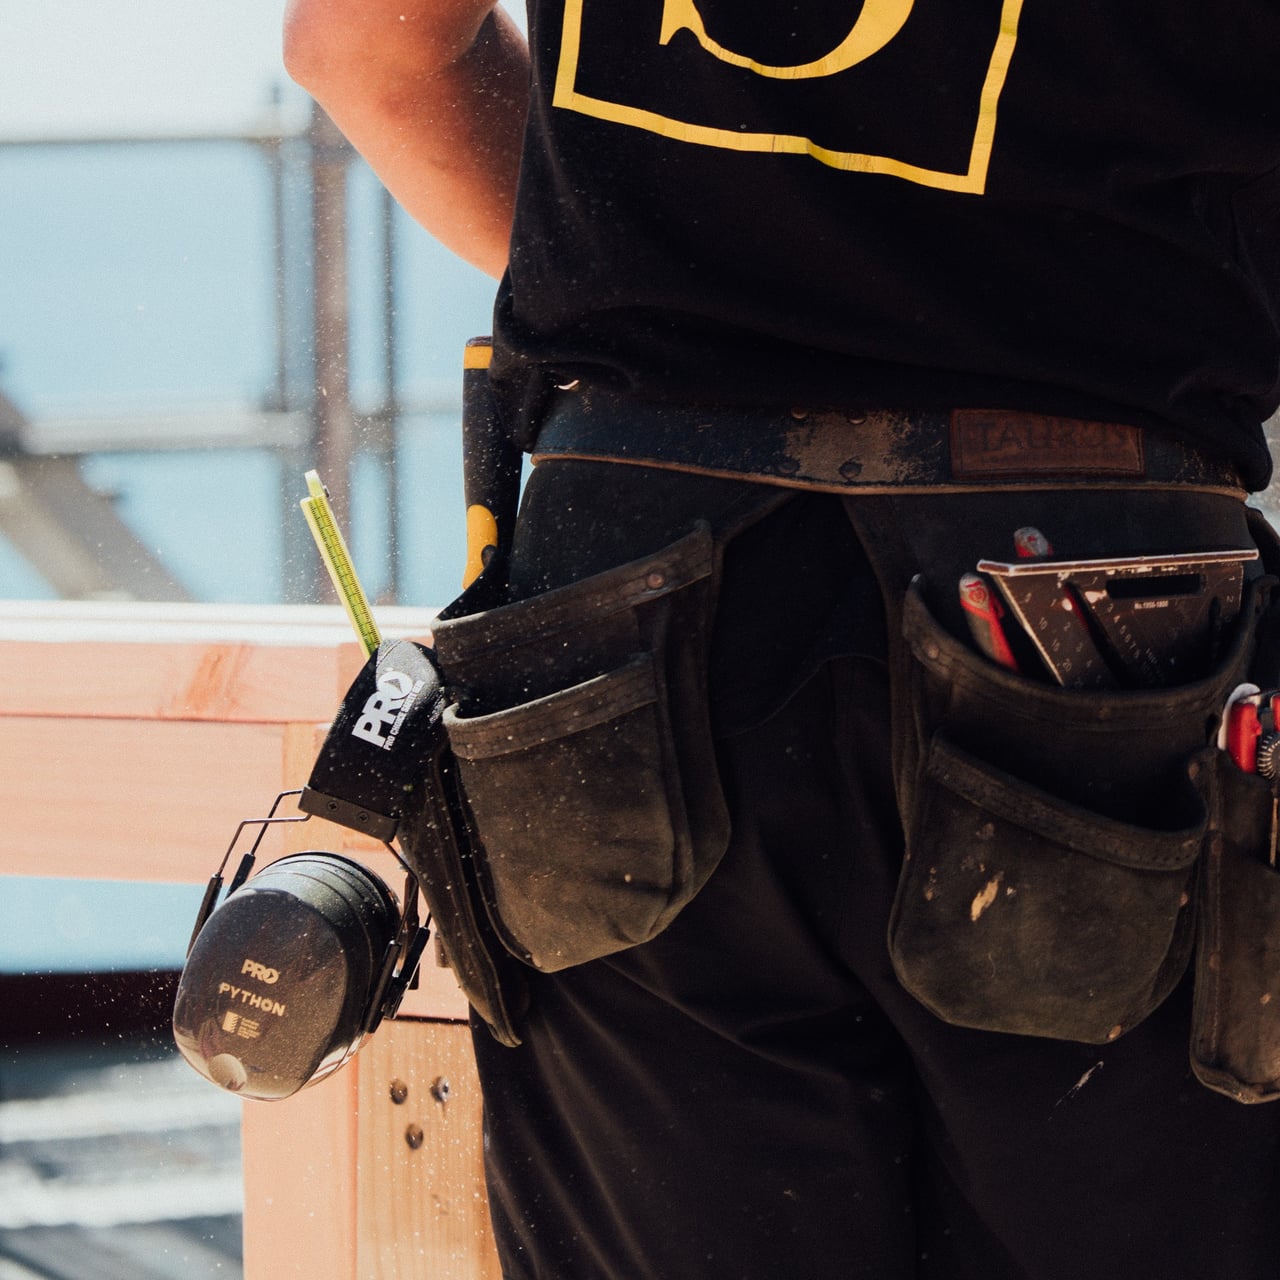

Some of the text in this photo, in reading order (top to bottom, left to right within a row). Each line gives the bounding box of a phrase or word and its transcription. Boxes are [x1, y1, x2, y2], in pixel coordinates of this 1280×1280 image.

[352, 671, 413, 748] PRO
[383, 735, 396, 751] PRO
[241, 959, 279, 984] PRO
[219, 982, 285, 1016] PYTHON
